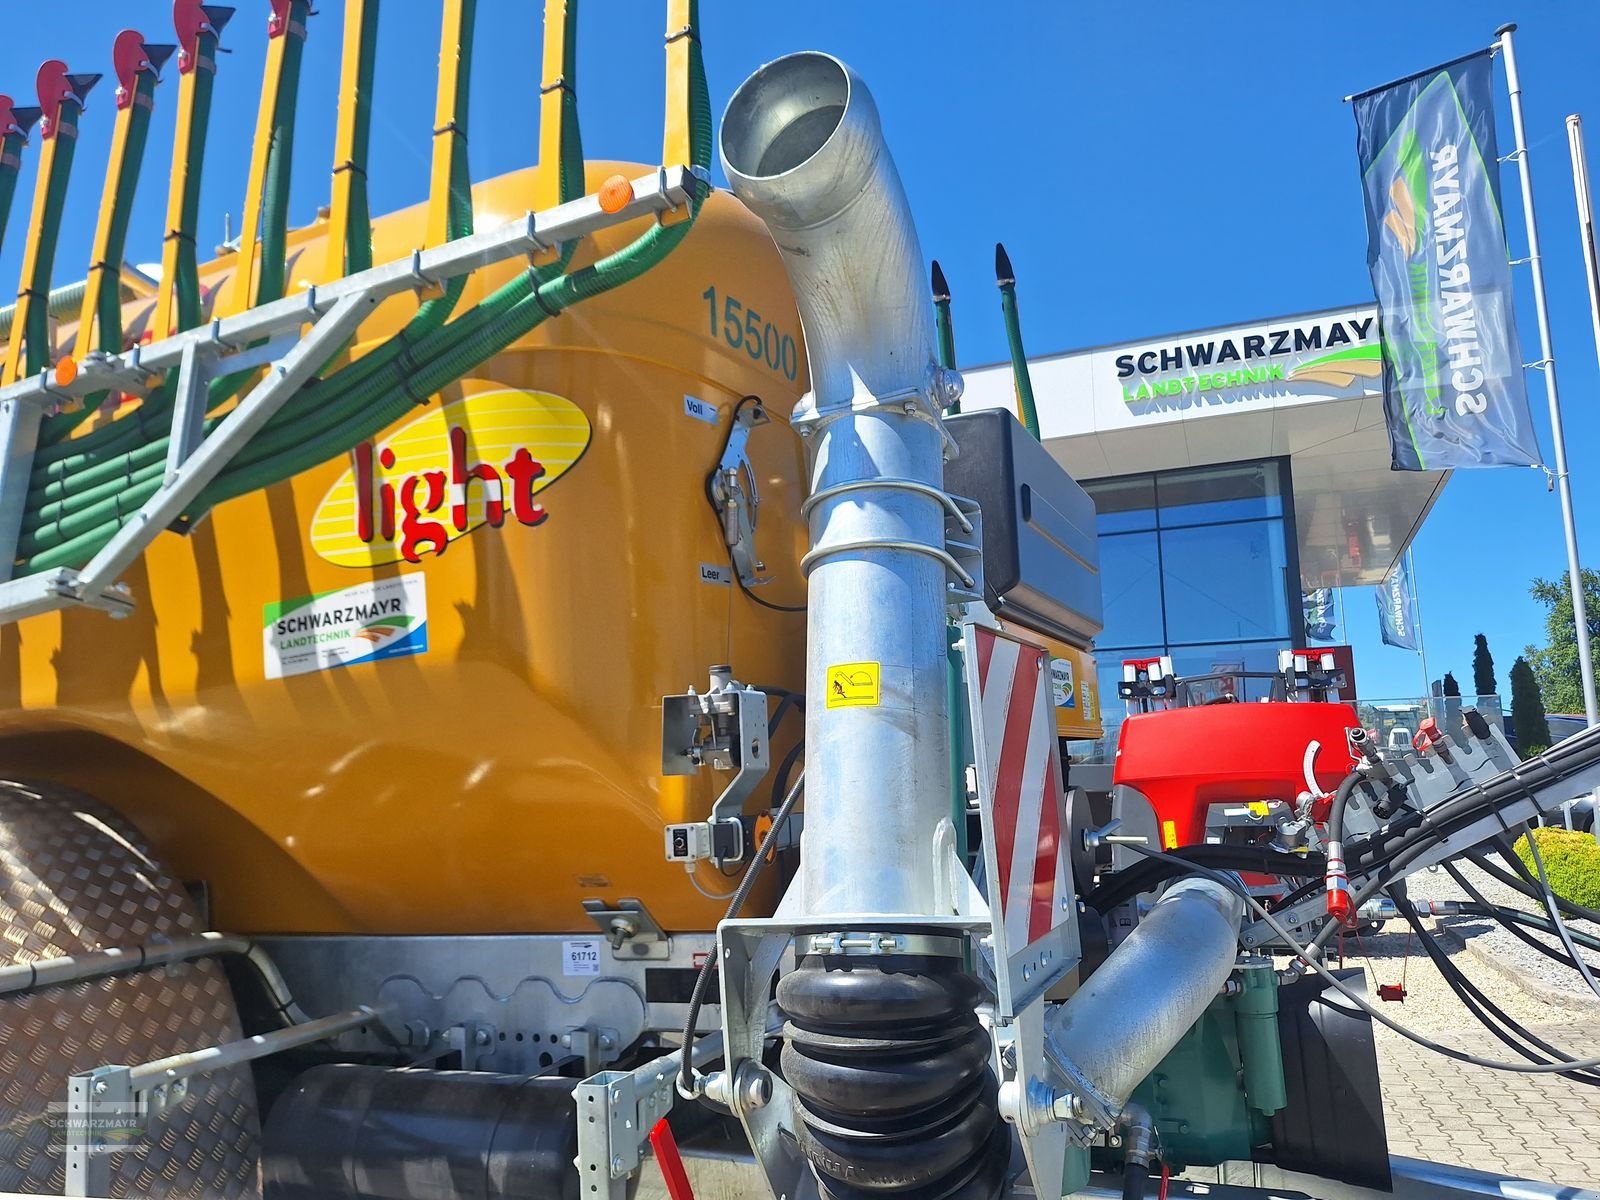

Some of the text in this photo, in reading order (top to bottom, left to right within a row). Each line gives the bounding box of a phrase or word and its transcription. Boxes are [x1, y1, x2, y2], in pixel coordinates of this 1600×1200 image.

[703, 285, 797, 381] 15500
[1115, 317, 1374, 377] SCHWARZMAY
[1122, 363, 1286, 402] LANDTECHNIK
[686, 399, 703, 415] Voll
[354, 425, 549, 563] light
[701, 566, 720, 580] Leer
[277, 598, 401, 635] SCHWARZMAYR
[279, 629, 352, 650] LANDTECHNIK
[571, 951, 597, 961] 61712
